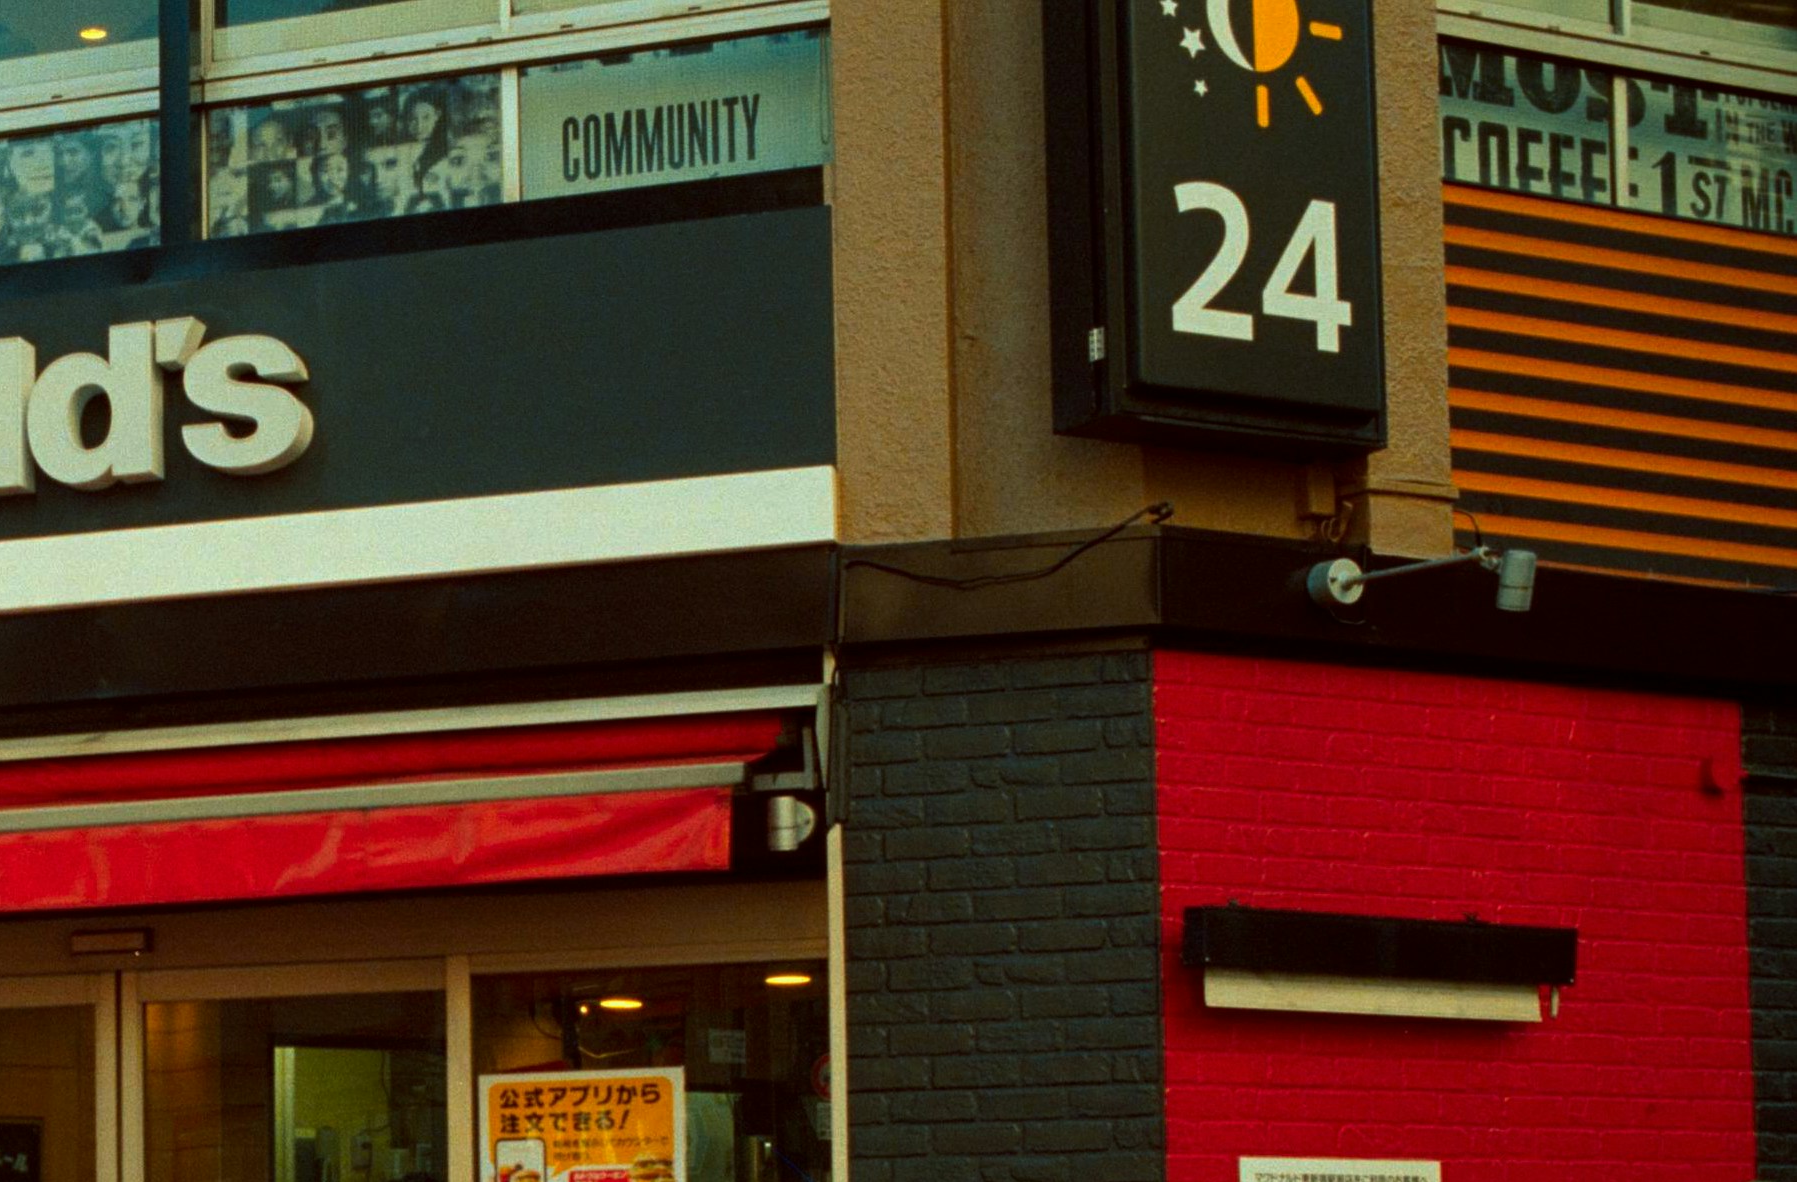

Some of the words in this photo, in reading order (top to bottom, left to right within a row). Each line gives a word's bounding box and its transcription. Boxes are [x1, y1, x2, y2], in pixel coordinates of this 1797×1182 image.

[563, 93, 760, 182] COMMUNITY
[1443, 115, 1640, 205] COFFE
[1173, 181, 1351, 352] 24
[499, 1083, 661, 1110] 公式アプリから
